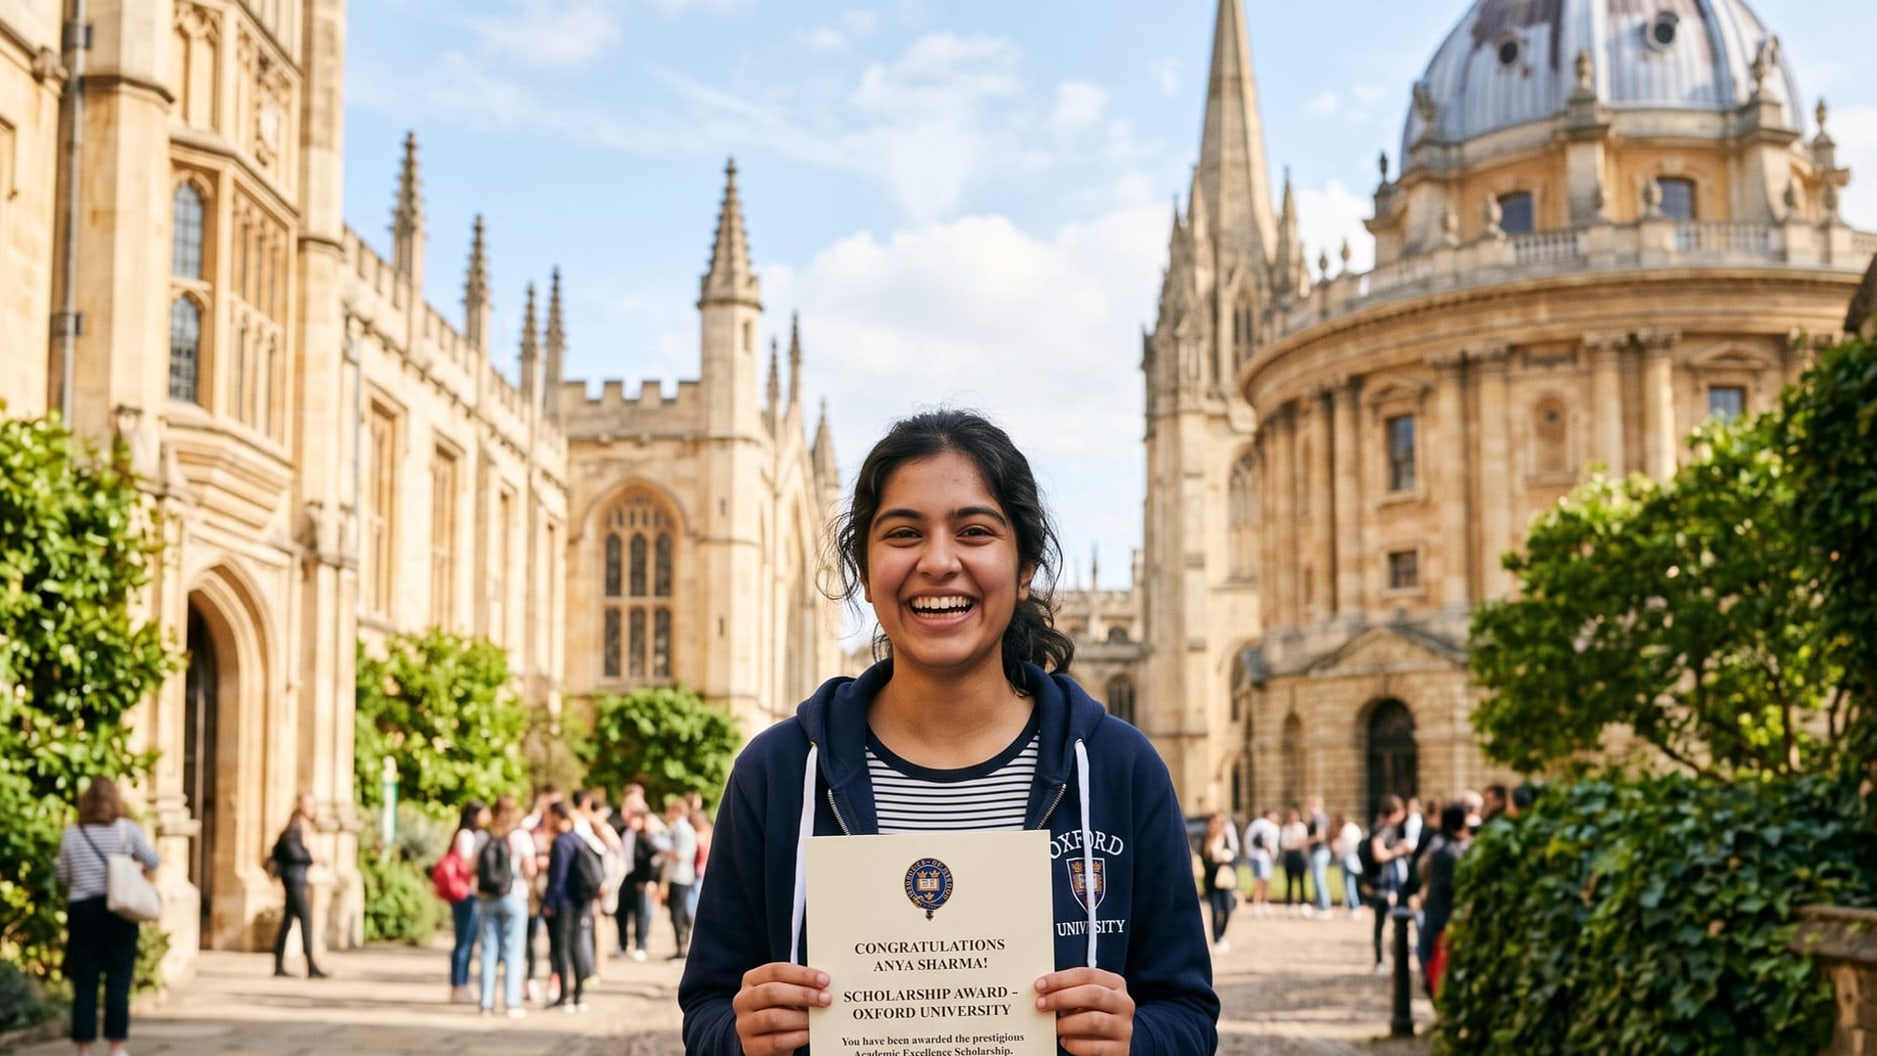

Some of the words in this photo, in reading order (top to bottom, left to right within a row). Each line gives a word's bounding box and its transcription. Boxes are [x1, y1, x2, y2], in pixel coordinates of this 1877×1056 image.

[1056, 919, 1125, 937] UNIVSITY
[854, 938, 1006, 955] CONGRATULATIONS
[873, 959, 915, 972] ANYA
[917, 956, 988, 971] SHARMA!
[843, 988, 952, 1003] SCHOLARSHIP
[953, 986, 1008, 1000] AWARD
[852, 1007, 916, 1020] OXFORD
[920, 1004, 1011, 1018] UNIVERSITY
[841, 1037, 860, 1046] You
[862, 1036, 885, 1046] have
[887, 1035, 909, 1045] been
[911, 1034, 952, 1044] awarded
[955, 1033, 971, 1043] the
[972, 1032, 1024, 1045] prestigious
[903, 1047, 952, 1056] Excellence
[954, 1046, 1014, 1056] Scholarship.
